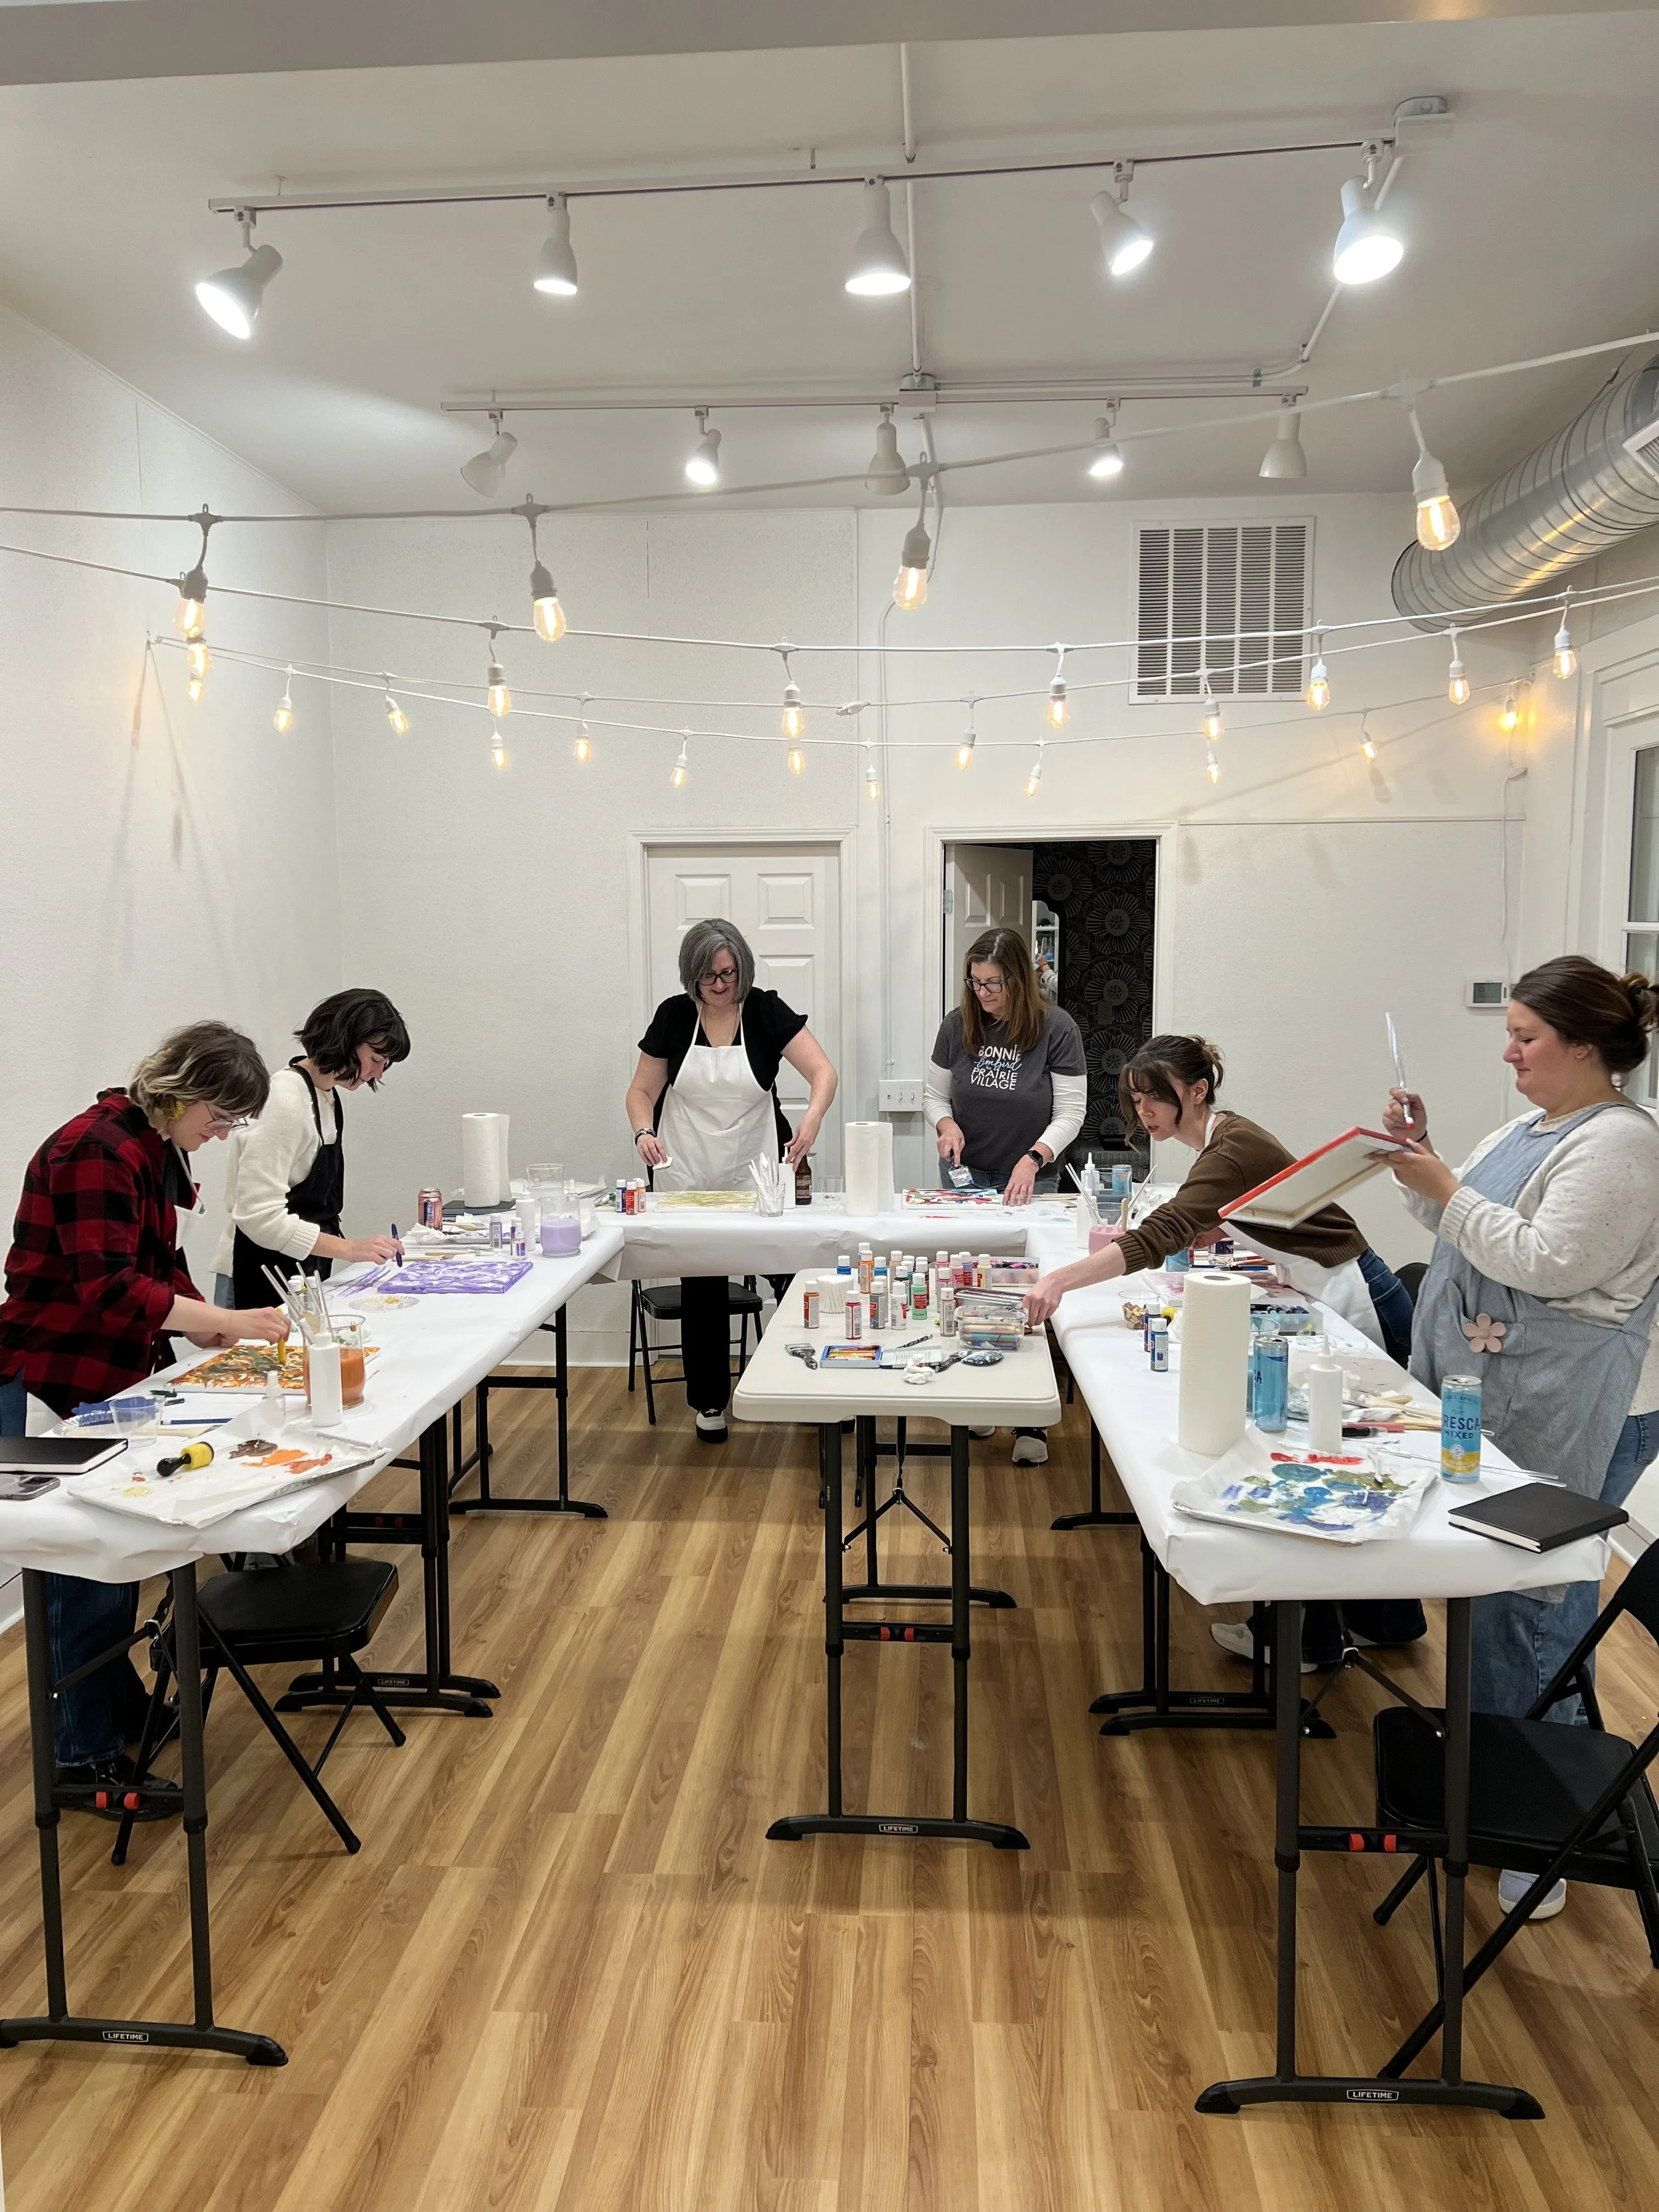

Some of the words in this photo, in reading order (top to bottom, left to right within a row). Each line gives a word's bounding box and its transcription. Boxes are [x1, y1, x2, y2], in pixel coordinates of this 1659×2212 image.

[978, 1045, 1021, 1061] BONNIE
[971, 1074, 1017, 1090] VILLAGE
[972, 1067, 1018, 1081] PRAIRIE
[1442, 1414, 1480, 1431] RESCA
[1445, 1430, 1474, 1440] MIXED
